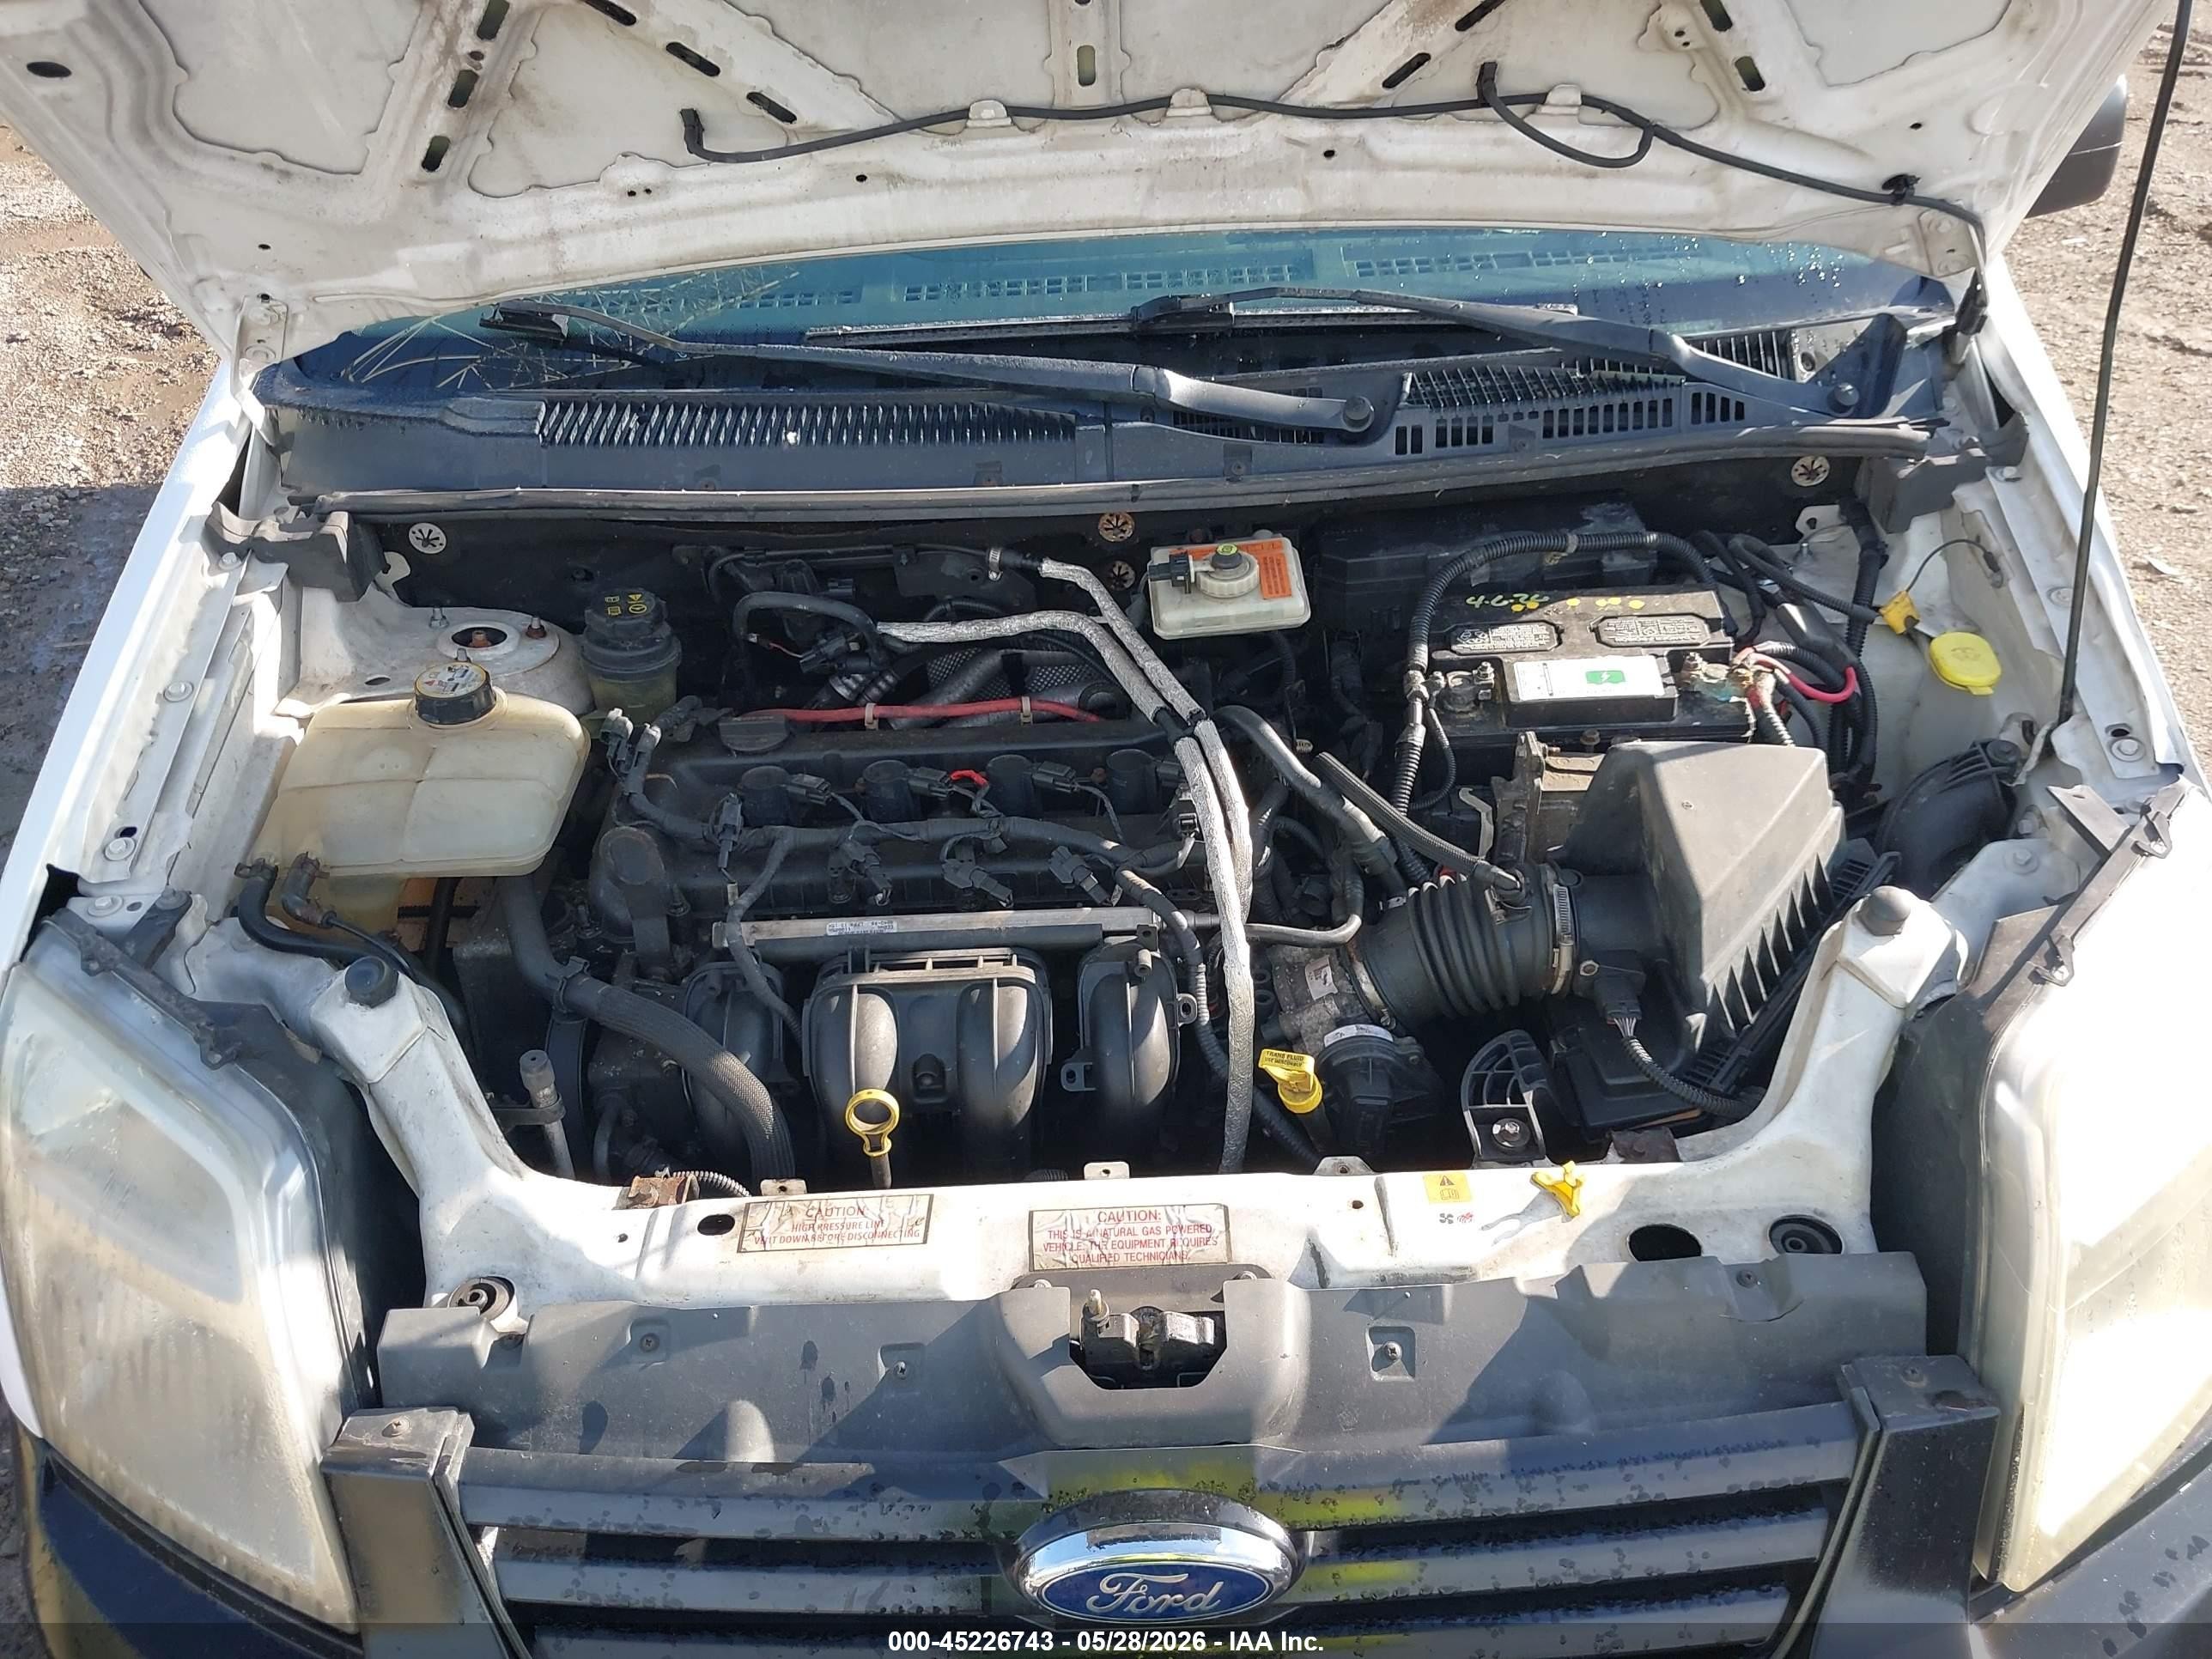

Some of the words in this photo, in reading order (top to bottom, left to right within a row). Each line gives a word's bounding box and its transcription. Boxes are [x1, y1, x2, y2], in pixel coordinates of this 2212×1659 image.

[1097, 1209, 1161, 1223] CAUTION:
[779, 1234, 809, 1243] DOWN
[1048, 1228, 1068, 1240] THIS
[1072, 1229, 1082, 1238] IS
[1094, 1225, 1139, 1237] NATURAL
[1141, 1225, 1162, 1236] GAS
[1165, 1223, 1212, 1235] POWERED
[1111, 1238, 1165, 1249] EQUIPMENT
[1085, 1573, 1224, 1613] Ford
